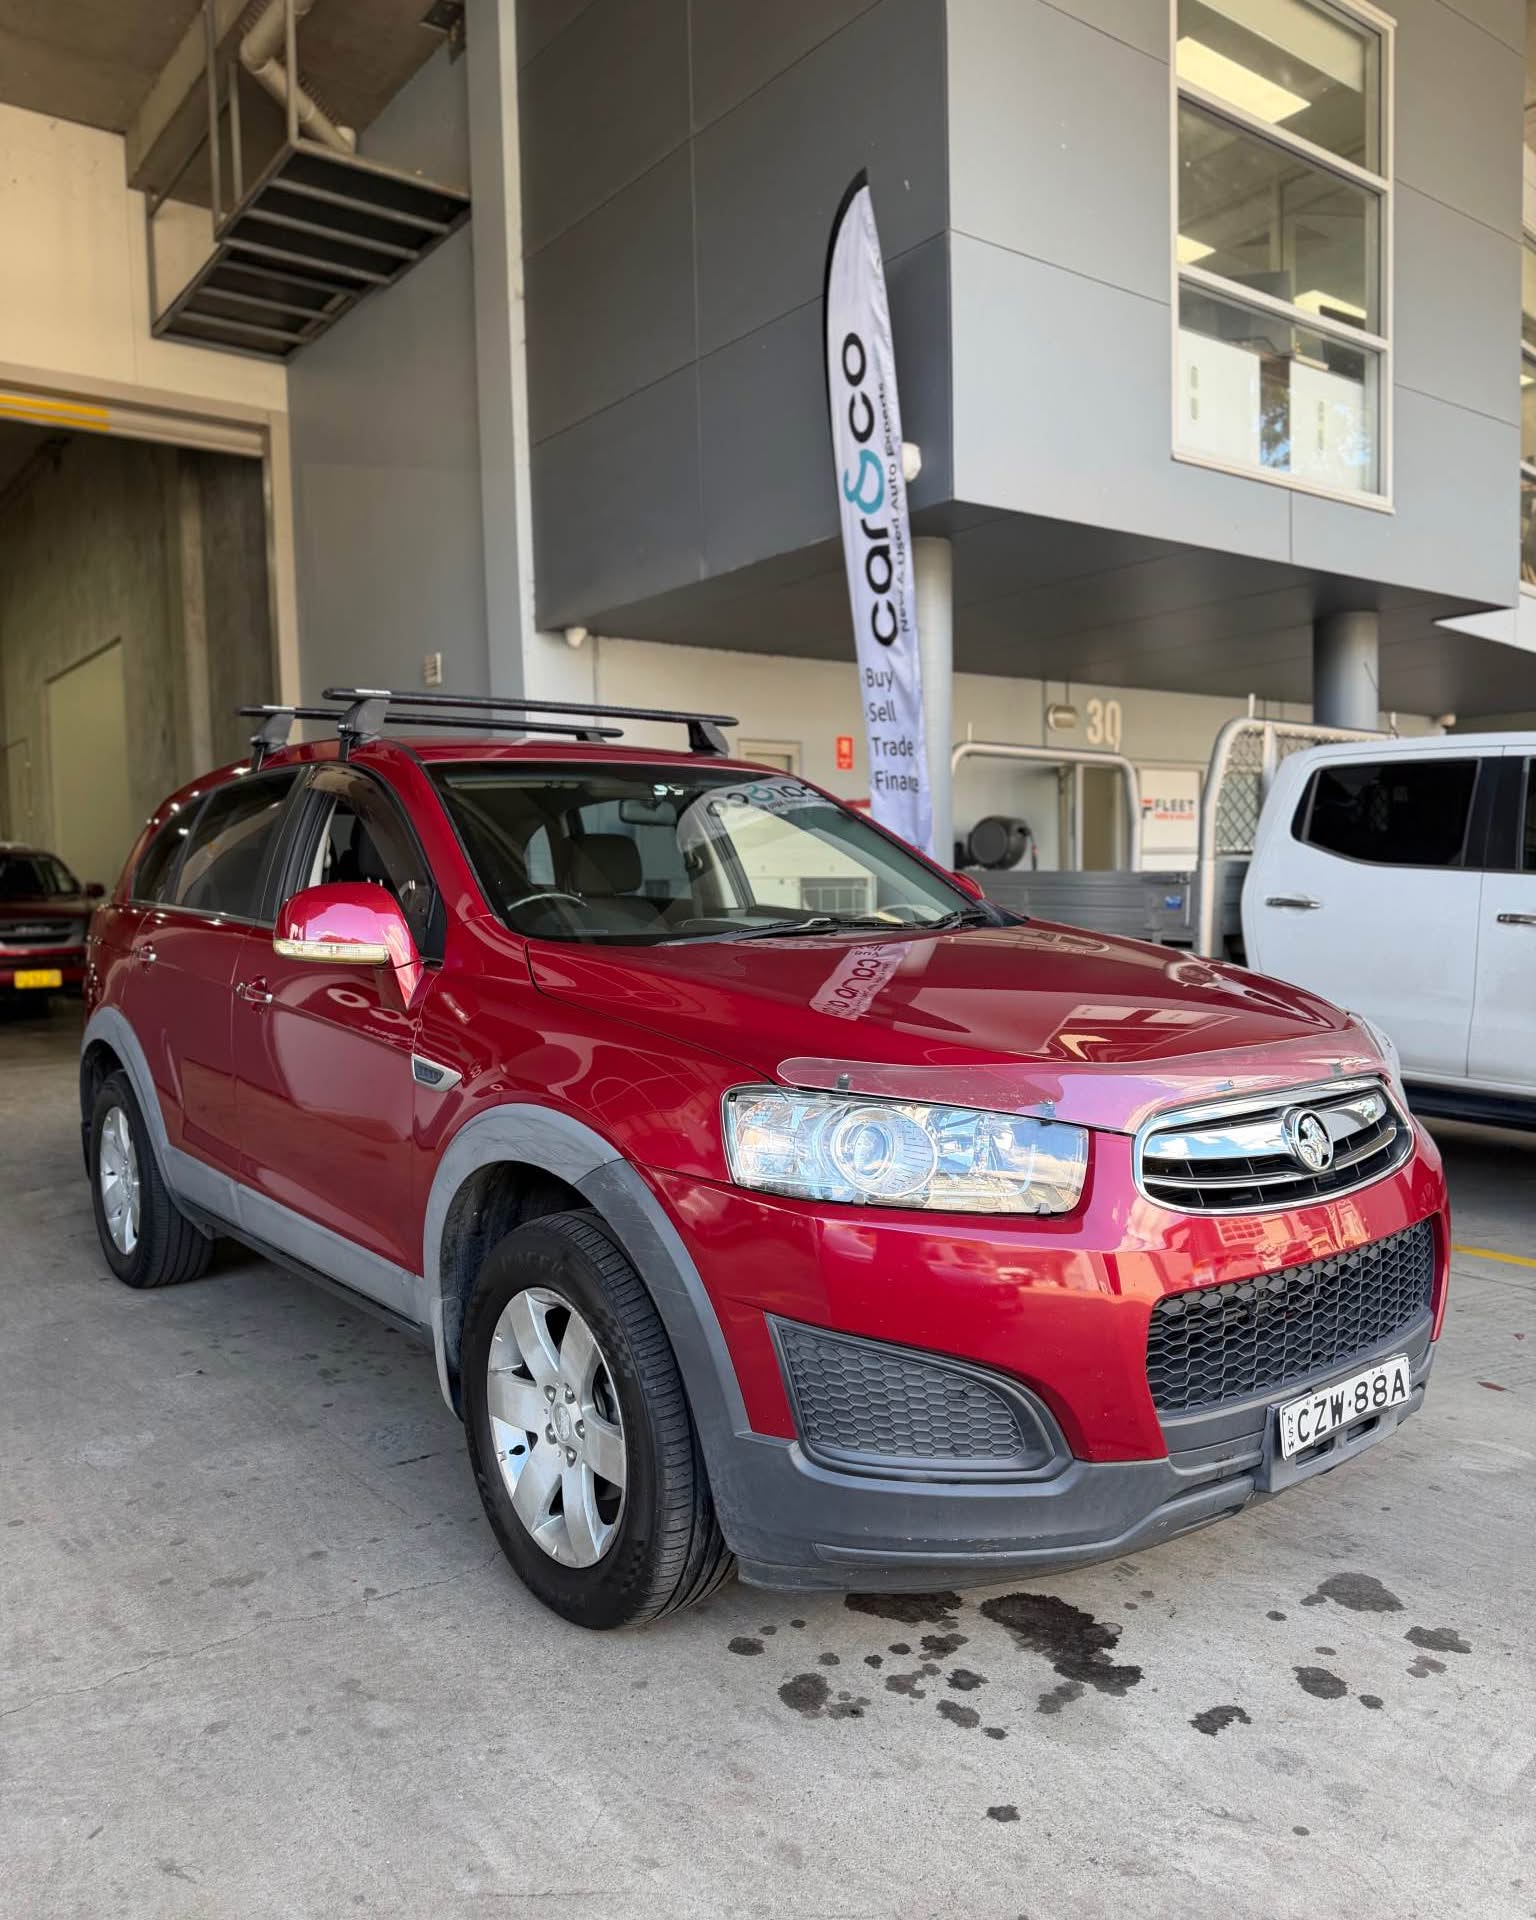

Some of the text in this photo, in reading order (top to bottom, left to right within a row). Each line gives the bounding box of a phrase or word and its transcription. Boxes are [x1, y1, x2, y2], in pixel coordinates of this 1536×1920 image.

[888, 463, 899, 510] Auto
[865, 667, 893, 692] Buy
[869, 701, 896, 722] Sell
[1087, 699, 1121, 745] 30
[872, 736, 914, 756] Trade
